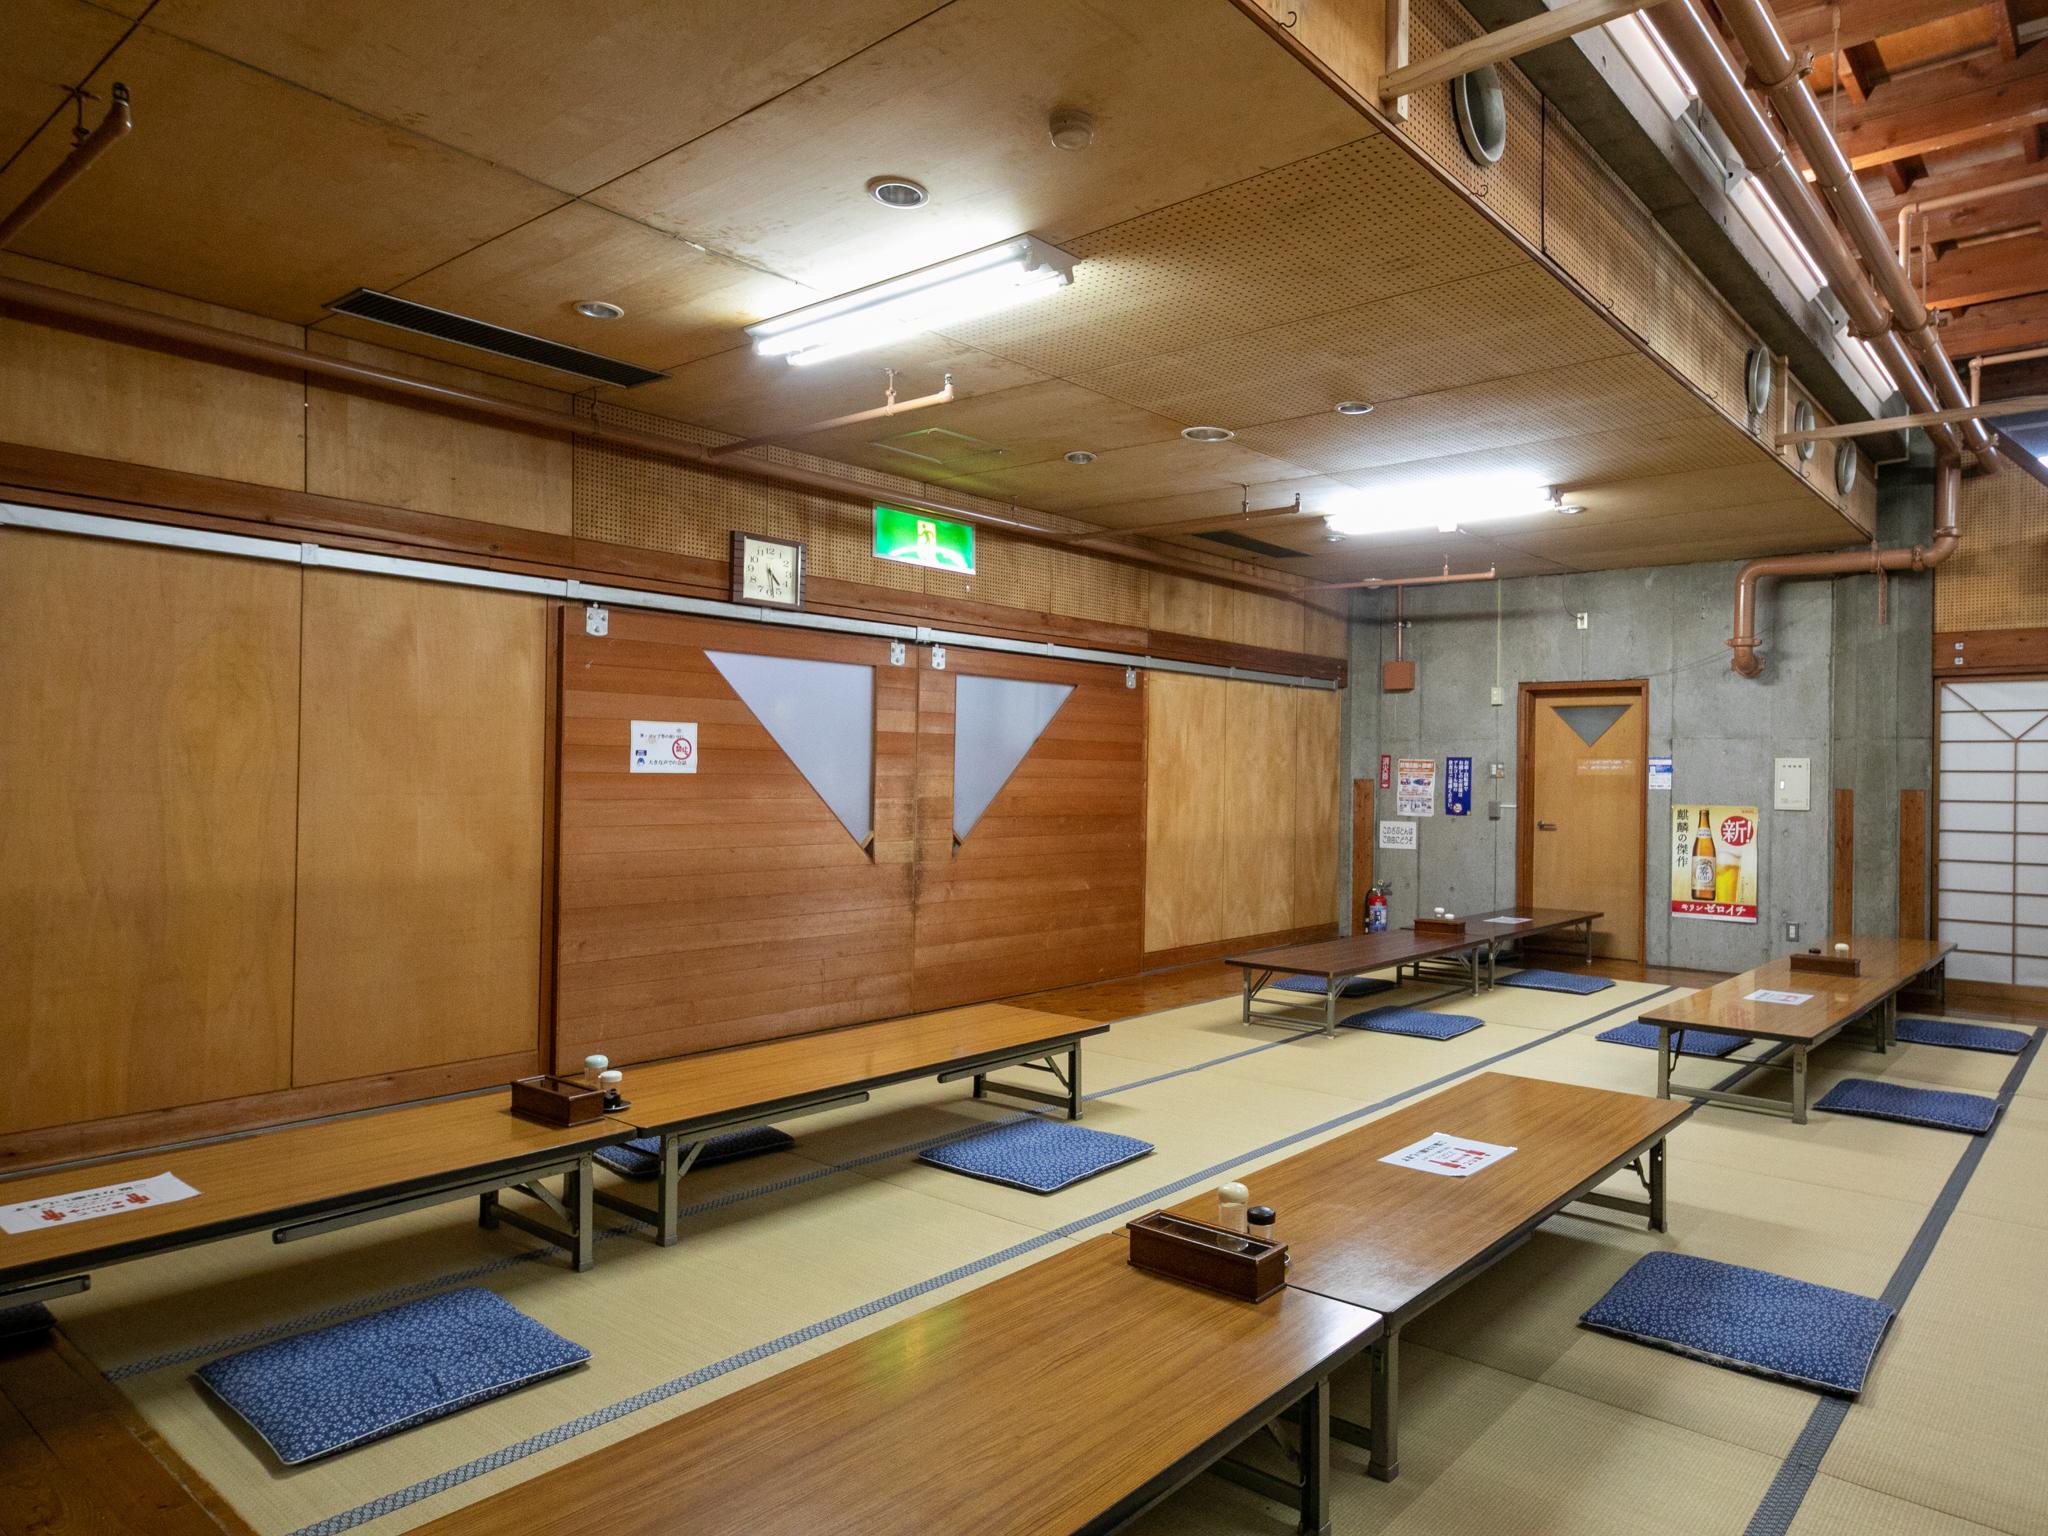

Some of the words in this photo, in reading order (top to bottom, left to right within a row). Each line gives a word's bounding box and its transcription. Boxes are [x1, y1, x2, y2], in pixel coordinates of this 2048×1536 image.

[766, 547, 775, 555] 12
[750, 555, 759, 563] 10
[757, 585, 764, 593] 7
[775, 587, 782, 595] 5
